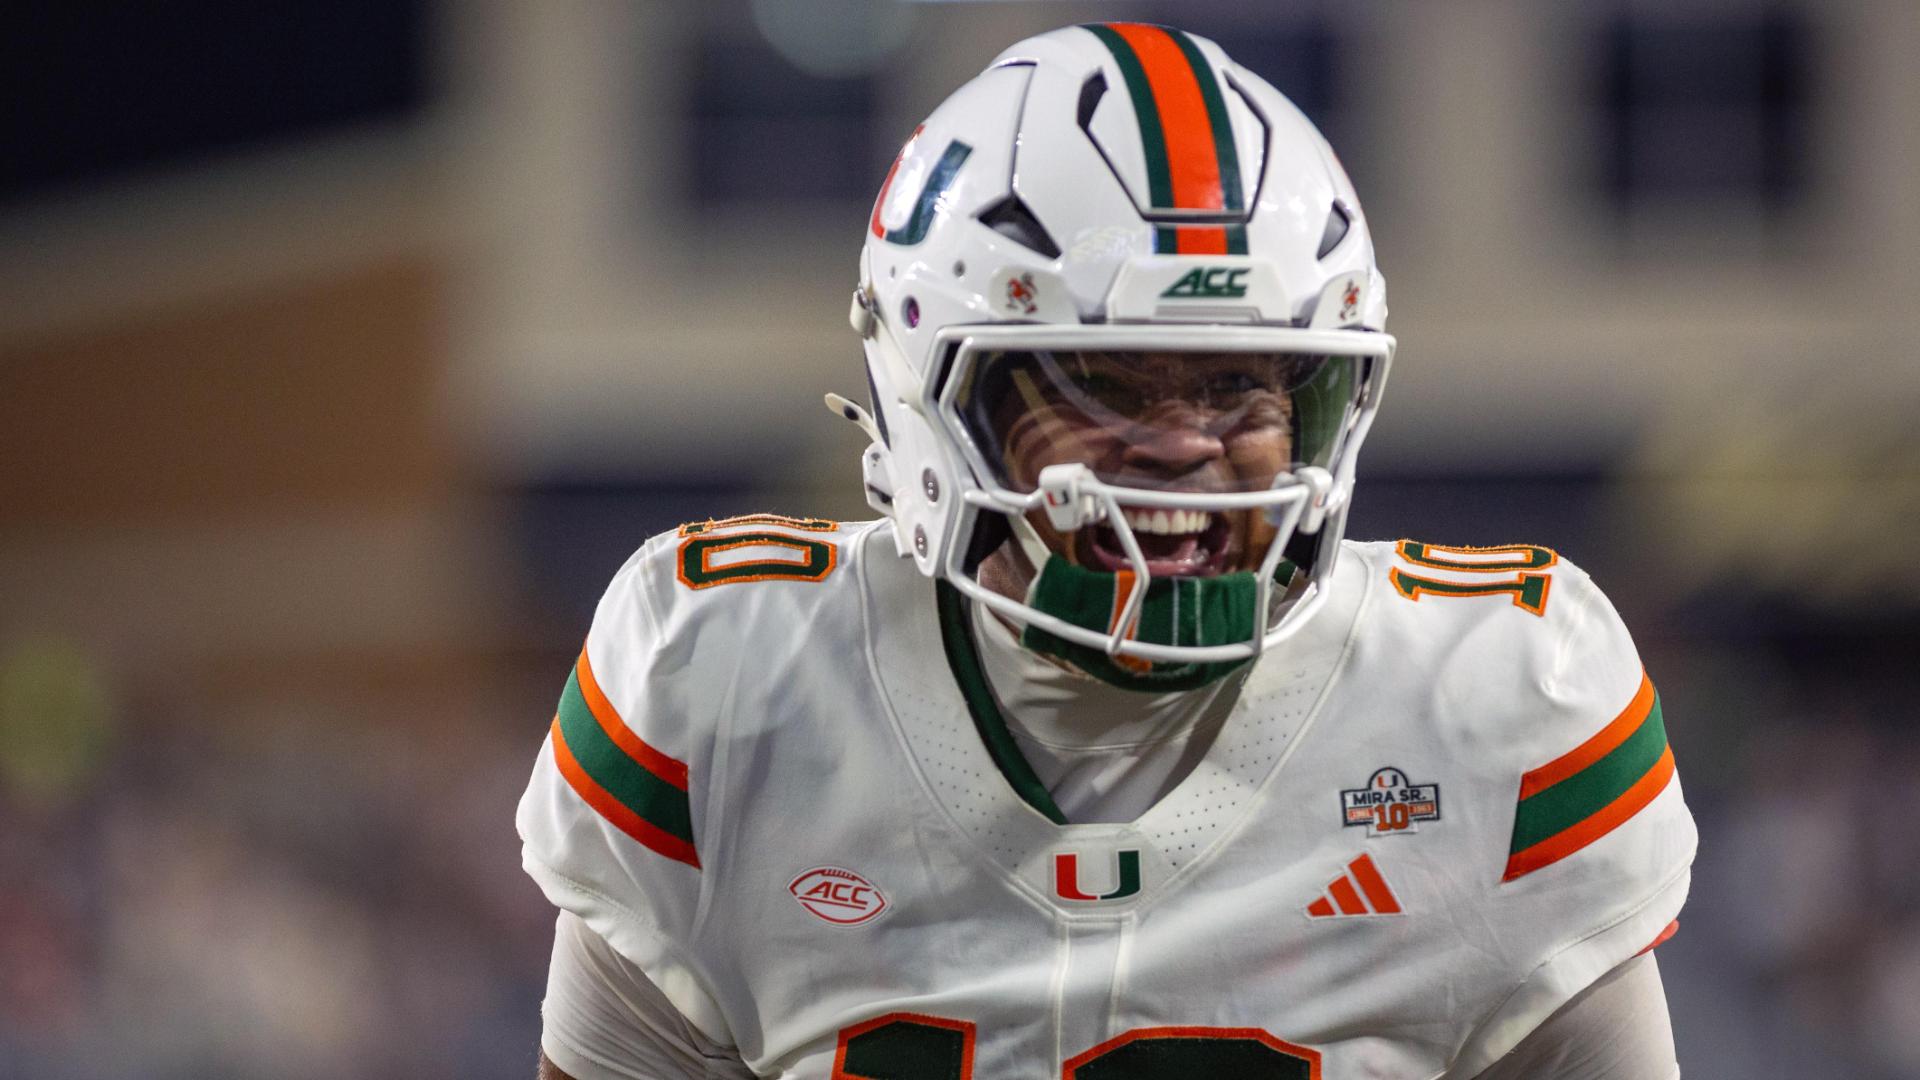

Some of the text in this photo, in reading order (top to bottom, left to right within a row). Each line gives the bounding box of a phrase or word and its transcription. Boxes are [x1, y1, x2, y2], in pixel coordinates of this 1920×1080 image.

[871, 123, 974, 246] U
[1160, 266, 1251, 298] ACC
[1388, 538, 1558, 617] 10
[1353, 788, 1427, 806] MIRA SR.
[1374, 802, 1409, 832] 10
[1055, 850, 1141, 900] U
[805, 880, 873, 906] ACC
